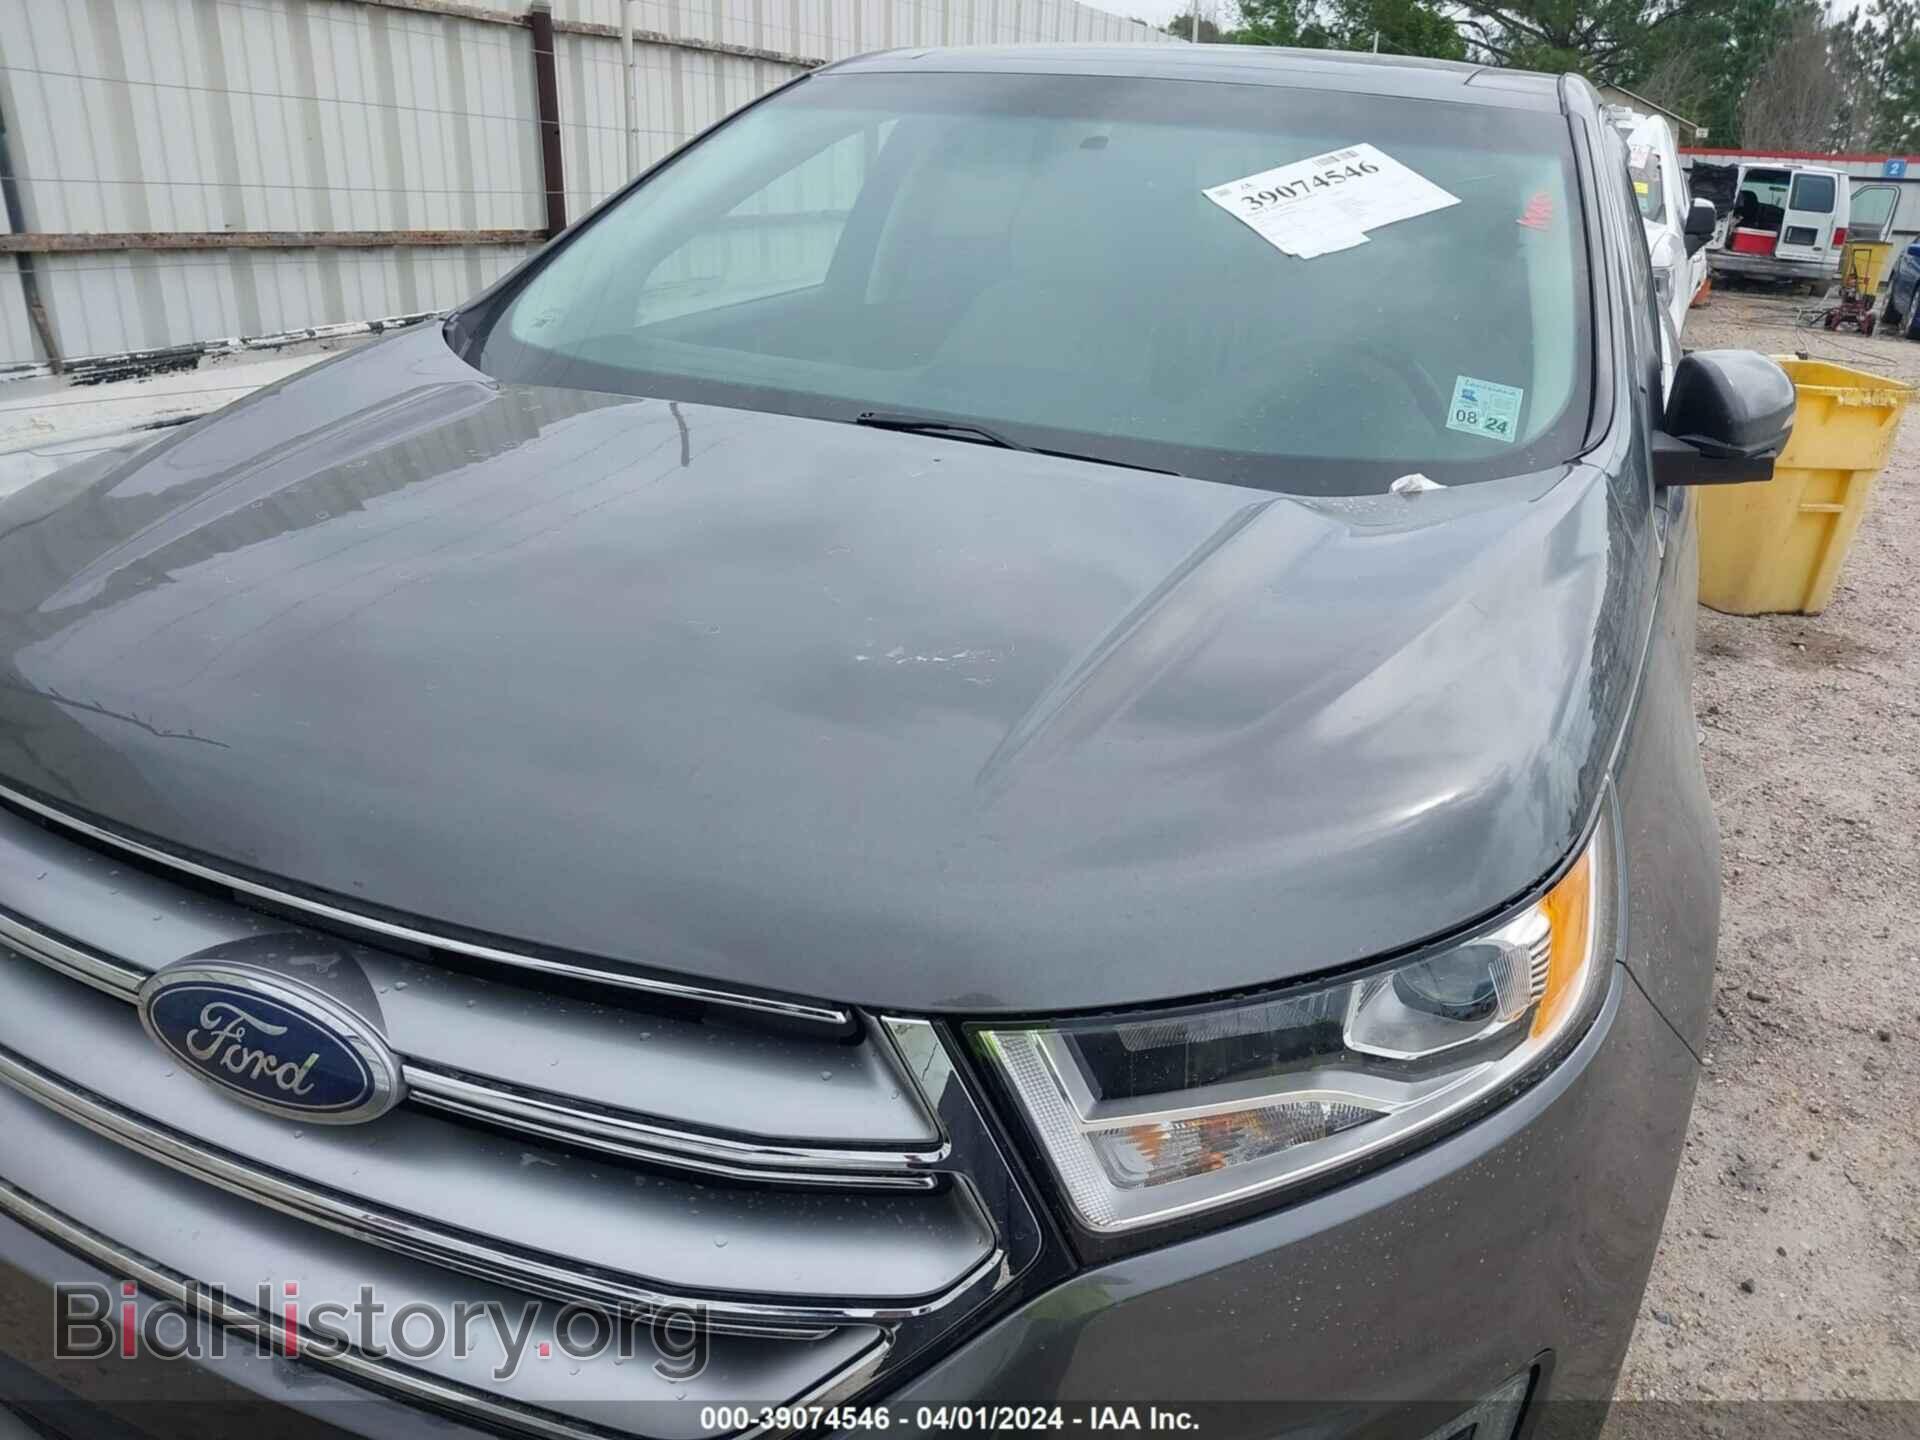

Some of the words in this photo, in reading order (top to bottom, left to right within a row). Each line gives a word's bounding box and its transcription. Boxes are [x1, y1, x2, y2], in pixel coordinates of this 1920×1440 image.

[1241, 160, 1380, 211] 39074546
[1889, 162, 1900, 175] 2
[1456, 409, 1477, 425] 08
[1484, 417, 1507, 433] 24
[186, 1002, 314, 1096] Ford
